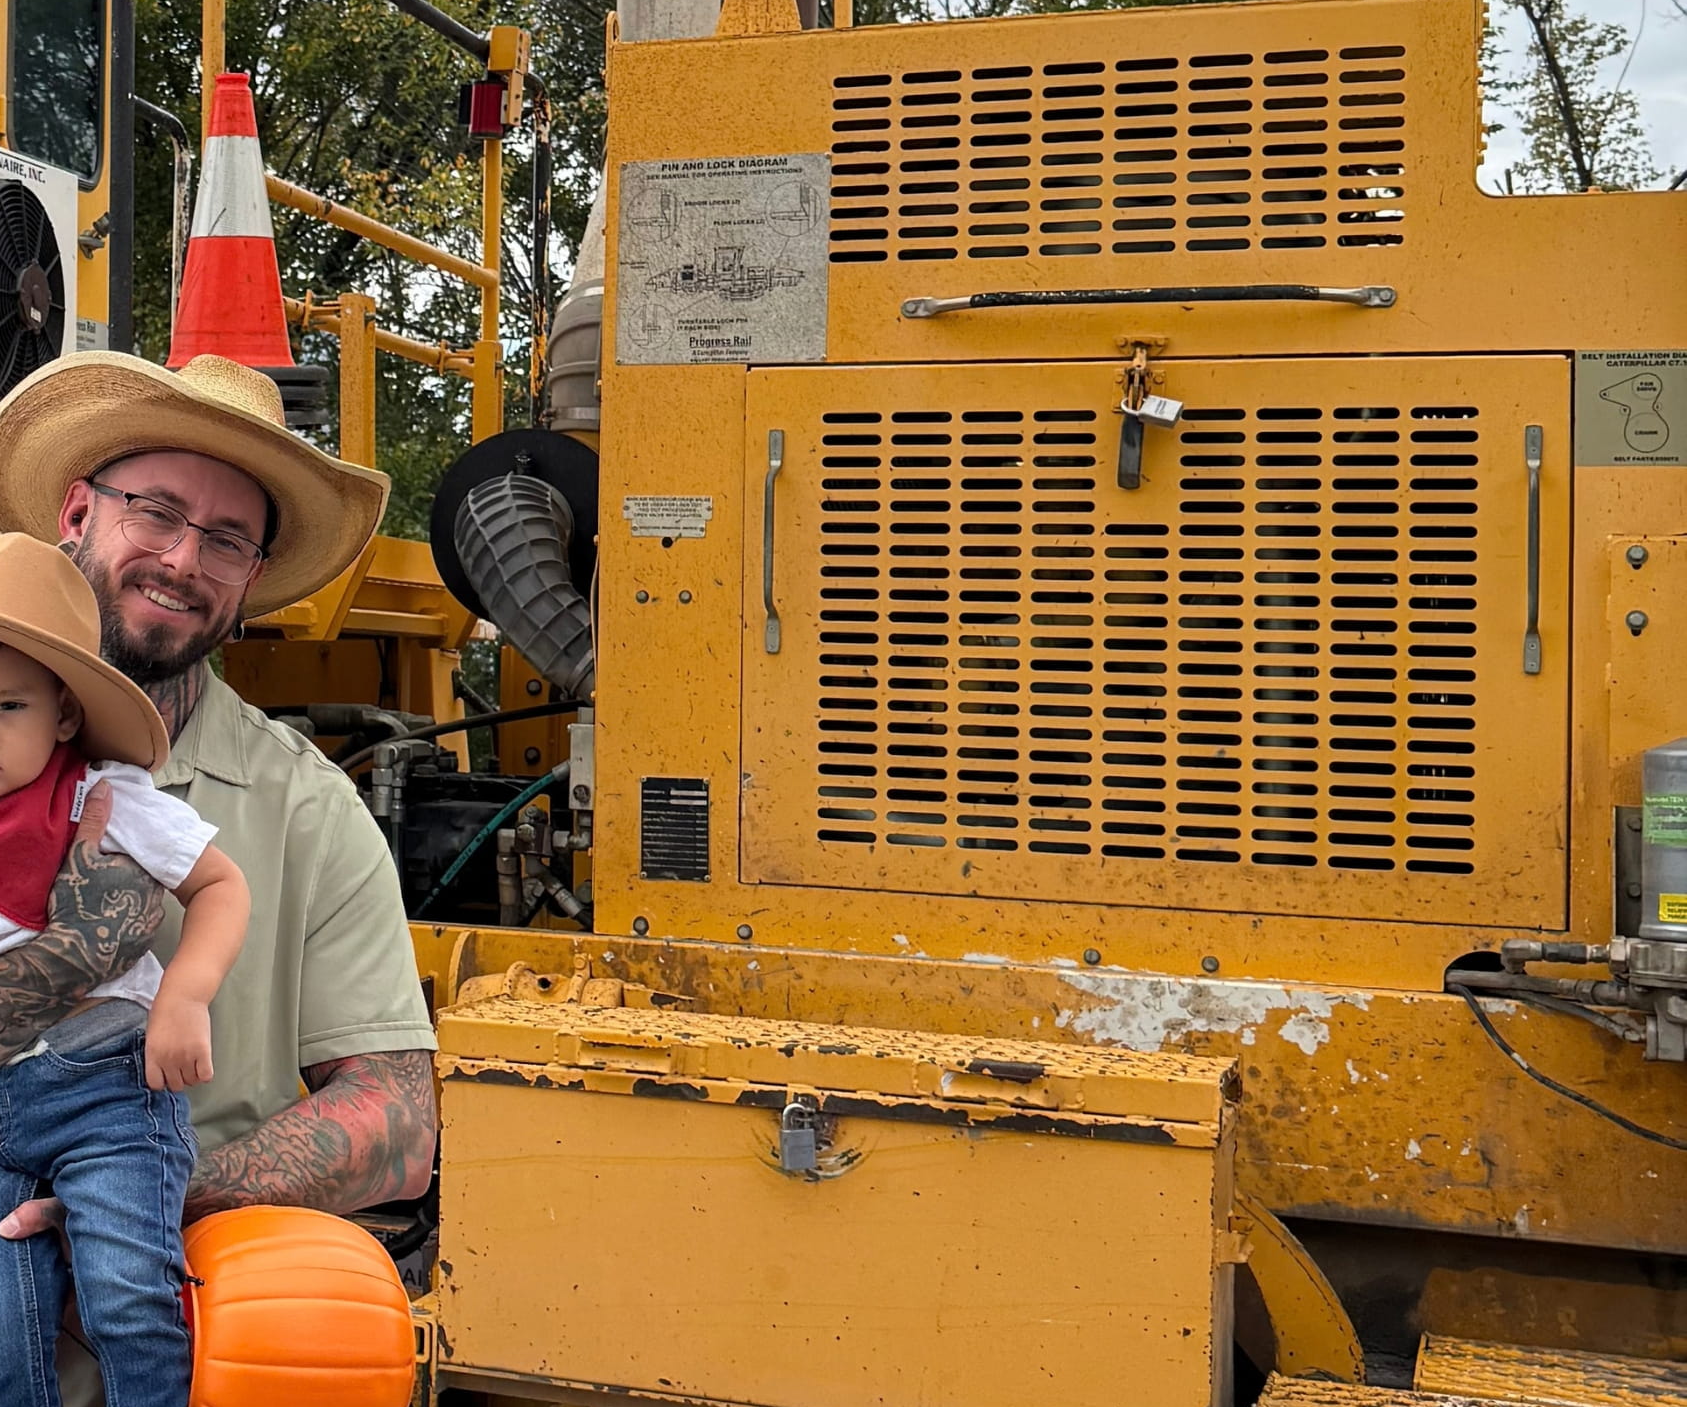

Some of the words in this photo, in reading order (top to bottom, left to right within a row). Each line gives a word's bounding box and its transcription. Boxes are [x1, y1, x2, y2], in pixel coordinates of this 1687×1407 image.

[662, 163, 679, 172] PIN
[682, 162, 704, 171] AND
[706, 160, 735, 170] LOCK
[739, 158, 788, 168] DIAGRAM
[28, 167, 46, 184] INC.
[708, 170, 747, 178] OPERATING
[750, 168, 803, 176] INSTRUCTIONS
[689, 336, 731, 348] Progress
[734, 335, 752, 345] Rail
